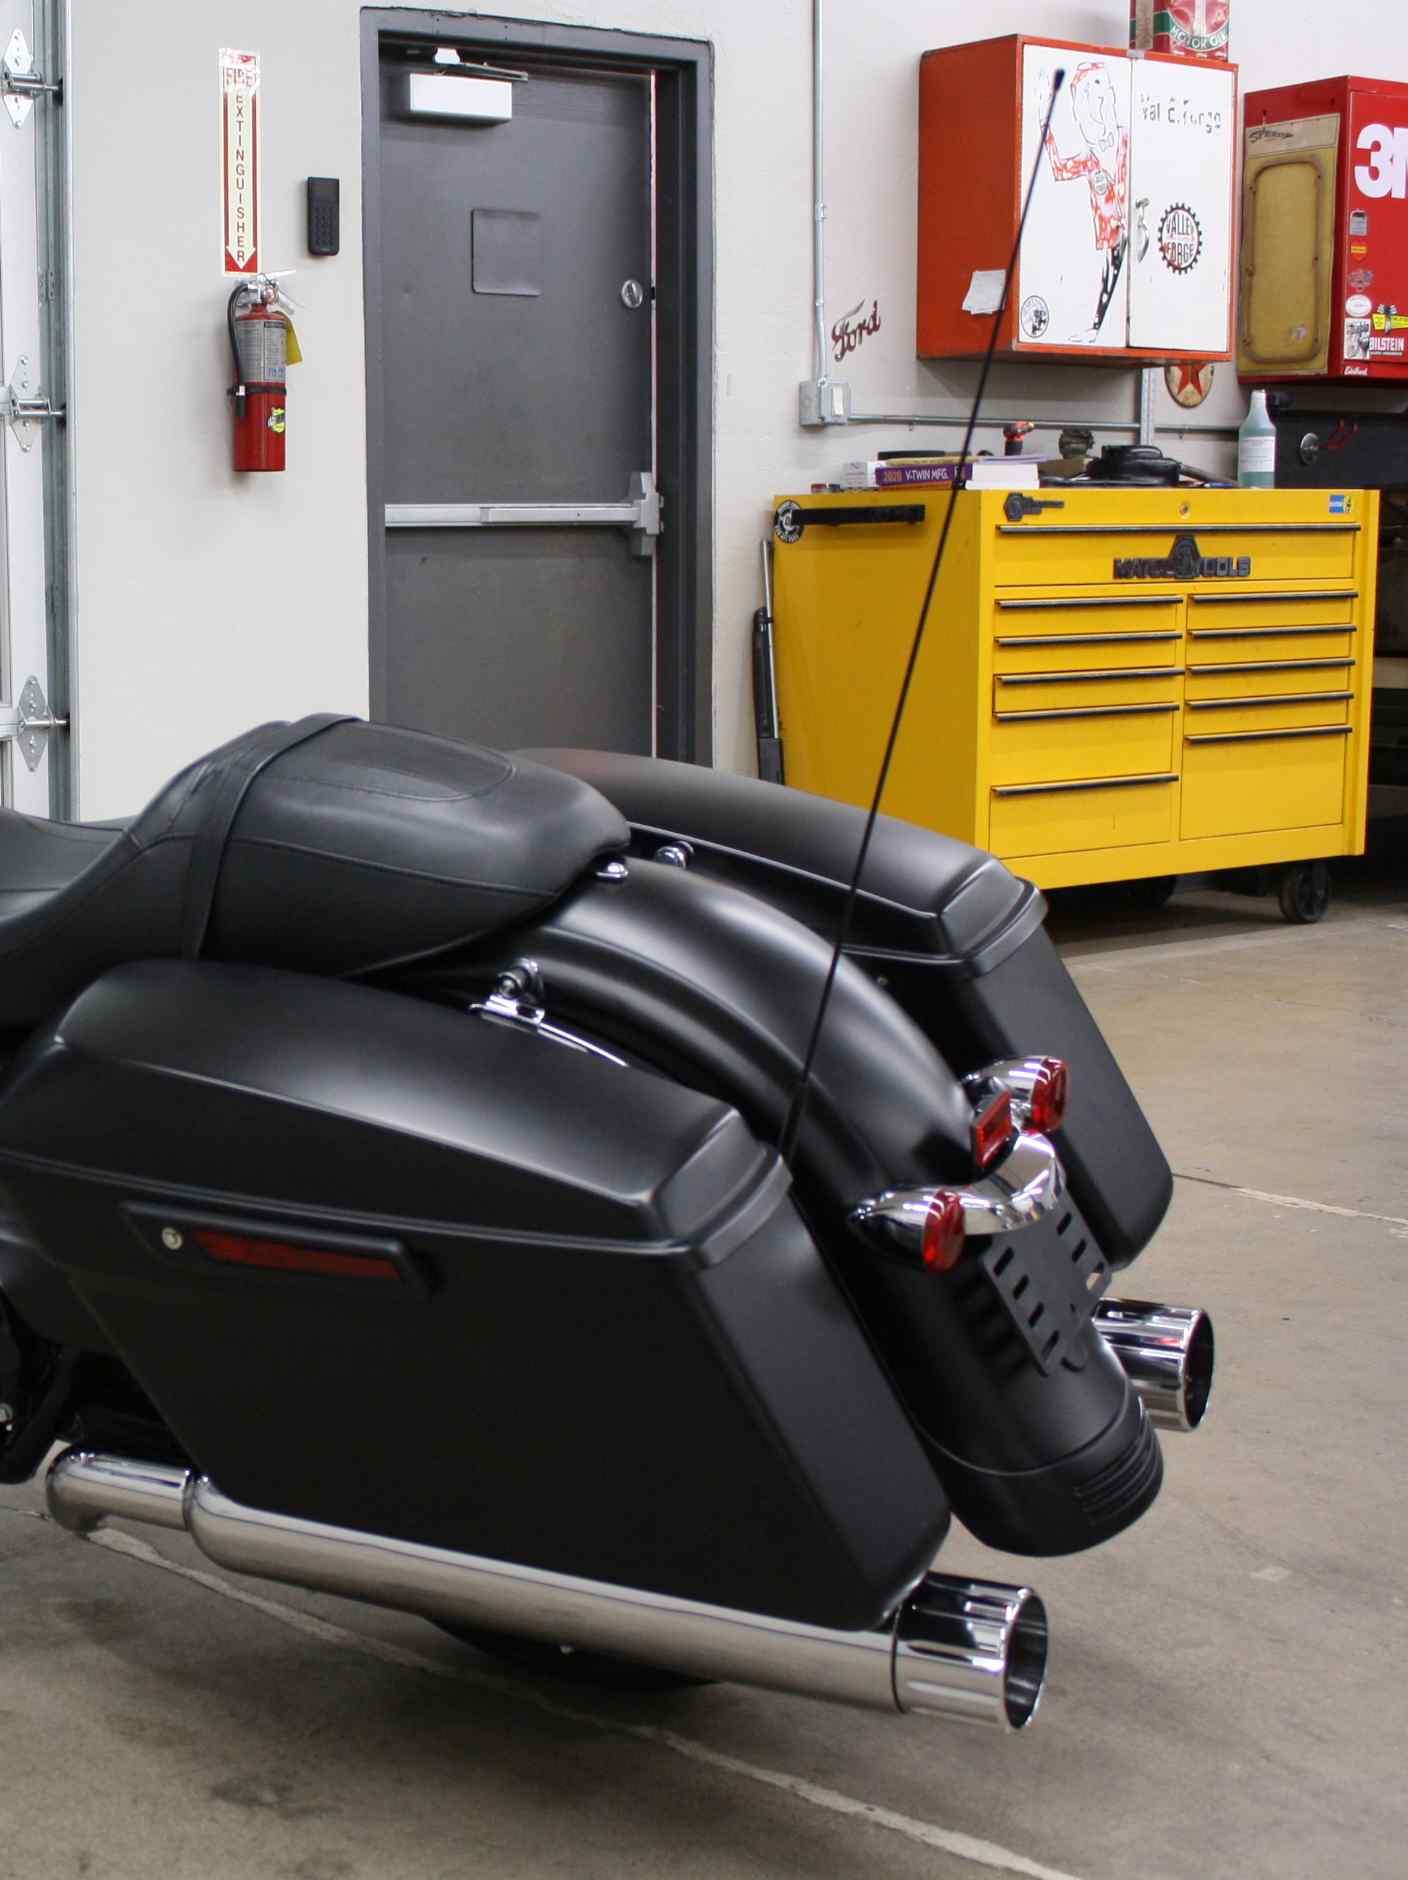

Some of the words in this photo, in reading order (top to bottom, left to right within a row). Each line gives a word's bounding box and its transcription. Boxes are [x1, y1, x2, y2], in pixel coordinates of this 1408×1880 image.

[235, 94, 246, 262] EXTINGUISHER
[832, 299, 881, 362] Ford
[1369, 336, 1405, 351] BILSTEIN
